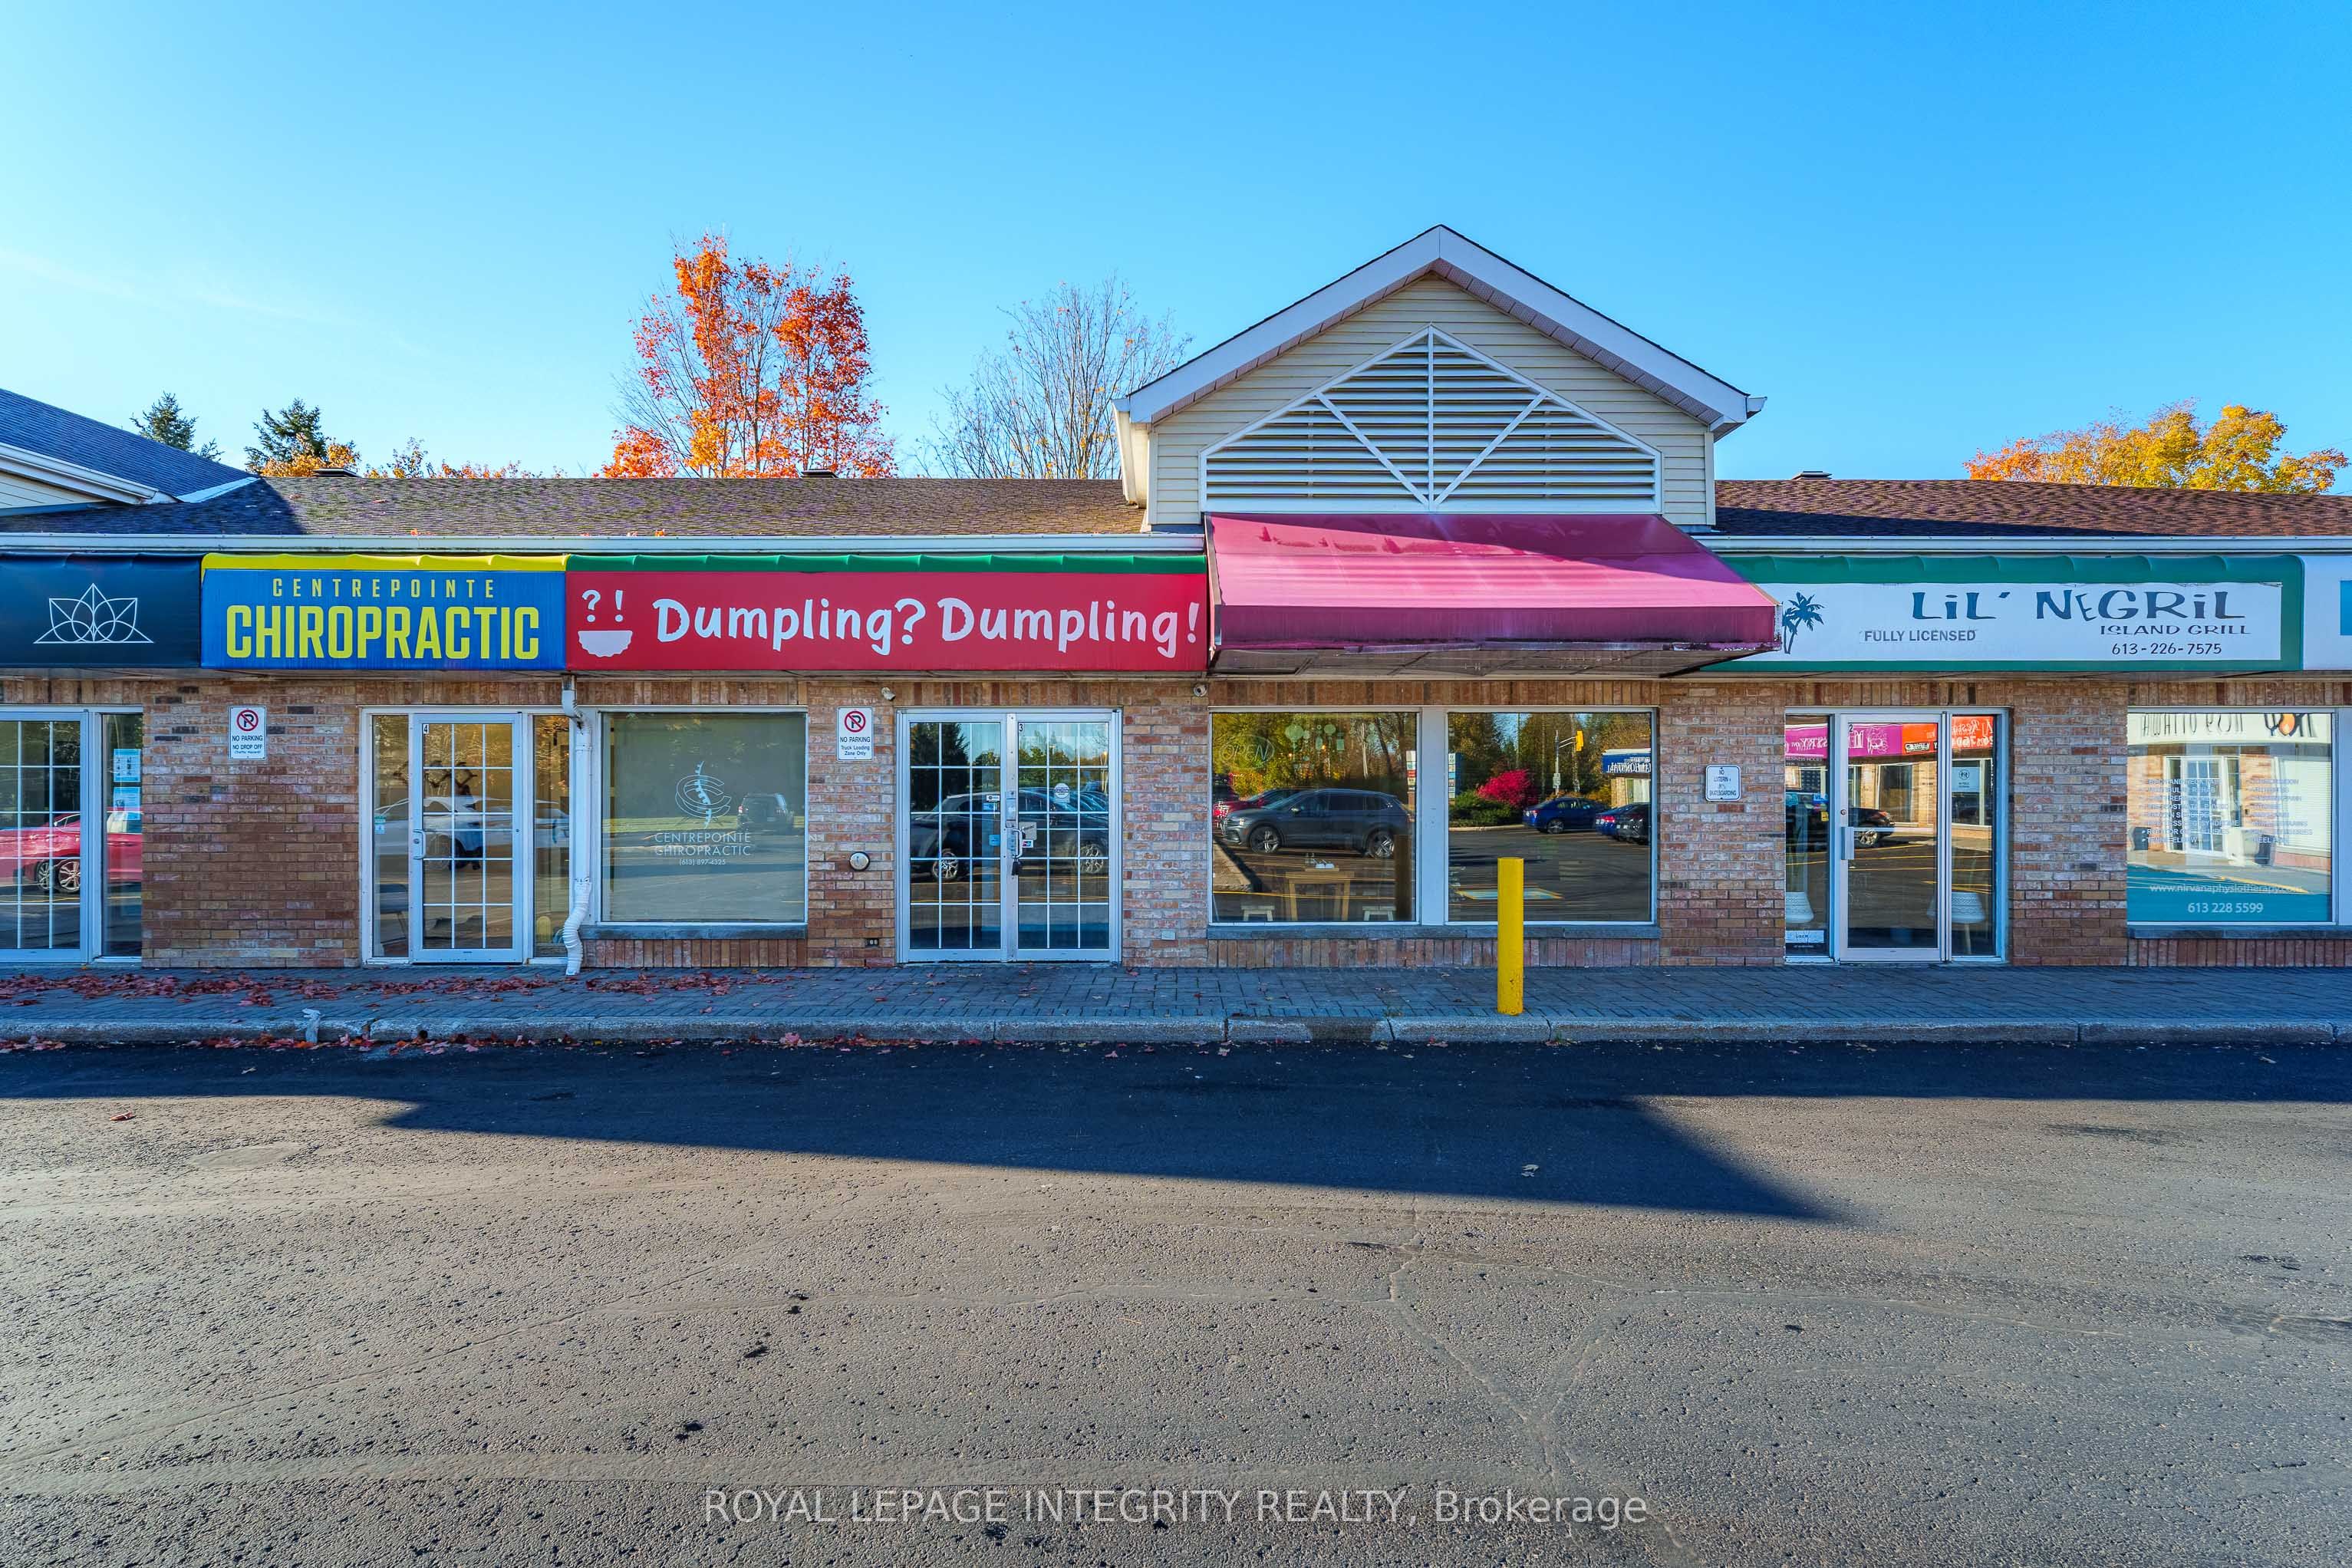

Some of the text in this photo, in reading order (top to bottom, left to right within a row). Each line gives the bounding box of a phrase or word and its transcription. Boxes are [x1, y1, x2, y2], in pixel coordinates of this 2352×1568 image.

[272, 578, 494, 598] CENTREPOINTE
[226, 605, 539, 660] CHIROPRACTIC
[652, 597, 1200, 658] Dumpling? Dumpling!
[2100, 624, 2253, 635] ISLAND GRILL
[1864, 629, 1977, 641] FULLY LICENSED
[423, 724, 428, 733] 4
[1019, 723, 1023, 732] 3
[1849, 724, 1853, 733] 2
[654, 832, 751, 843] CENTREPOINTE
[654, 845, 752, 856] CHIROPRACTIC
[2188, 902, 2264, 913] 613 228 5599
